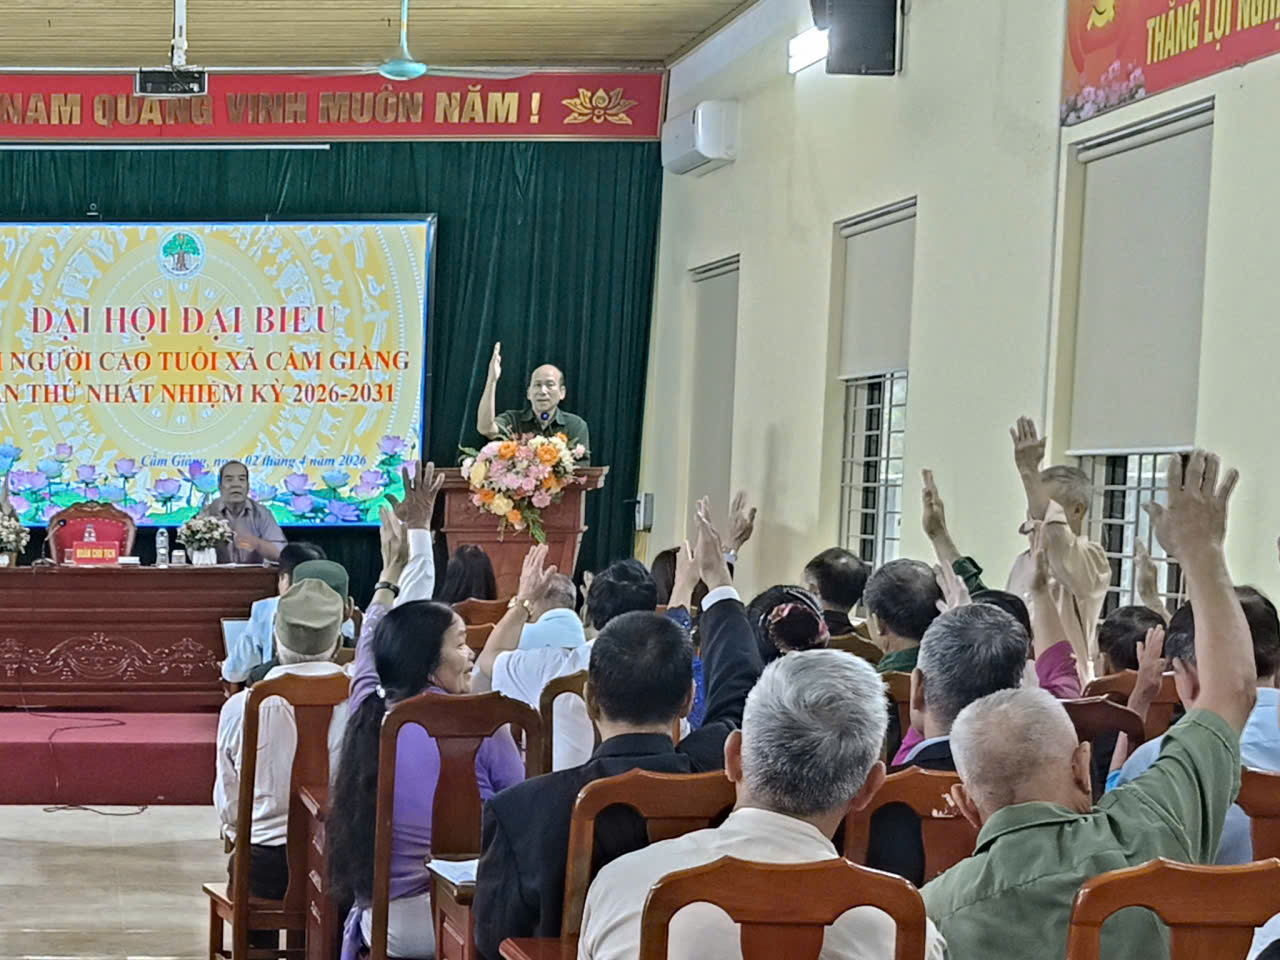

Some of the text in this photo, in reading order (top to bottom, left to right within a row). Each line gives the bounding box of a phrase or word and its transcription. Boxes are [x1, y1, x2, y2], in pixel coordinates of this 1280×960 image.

[0, 93, 82, 125] NAM
[93, 94, 214, 128] QUANG
[226, 92, 308, 124] VINH
[318, 83, 424, 124] MUÔN
[434, 84, 520, 124] NĂM
[32, 306, 90, 341] ĐẠI
[181, 306, 241, 341] ĐẠI
[10, 346, 92, 371] NGƯỜI
[99, 351, 152, 371] CAO
[157, 346, 218, 371] TUỔI
[225, 346, 258, 371] XÃ
[330, 345, 410, 370] GIÀNG
[26, 378, 82, 404] THỨ
[87, 378, 154, 404] NHẤT
[161, 380, 243, 409] NHIỆM
[252, 379, 285, 404] KỲ
[292, 383, 394, 403] 2026-2031
[245, 455, 260, 467] 02
[262, 455, 298, 469] tháng
[299, 455, 308, 467] 4
[310, 455, 336, 467] năm
[338, 455, 368, 467] 2026
